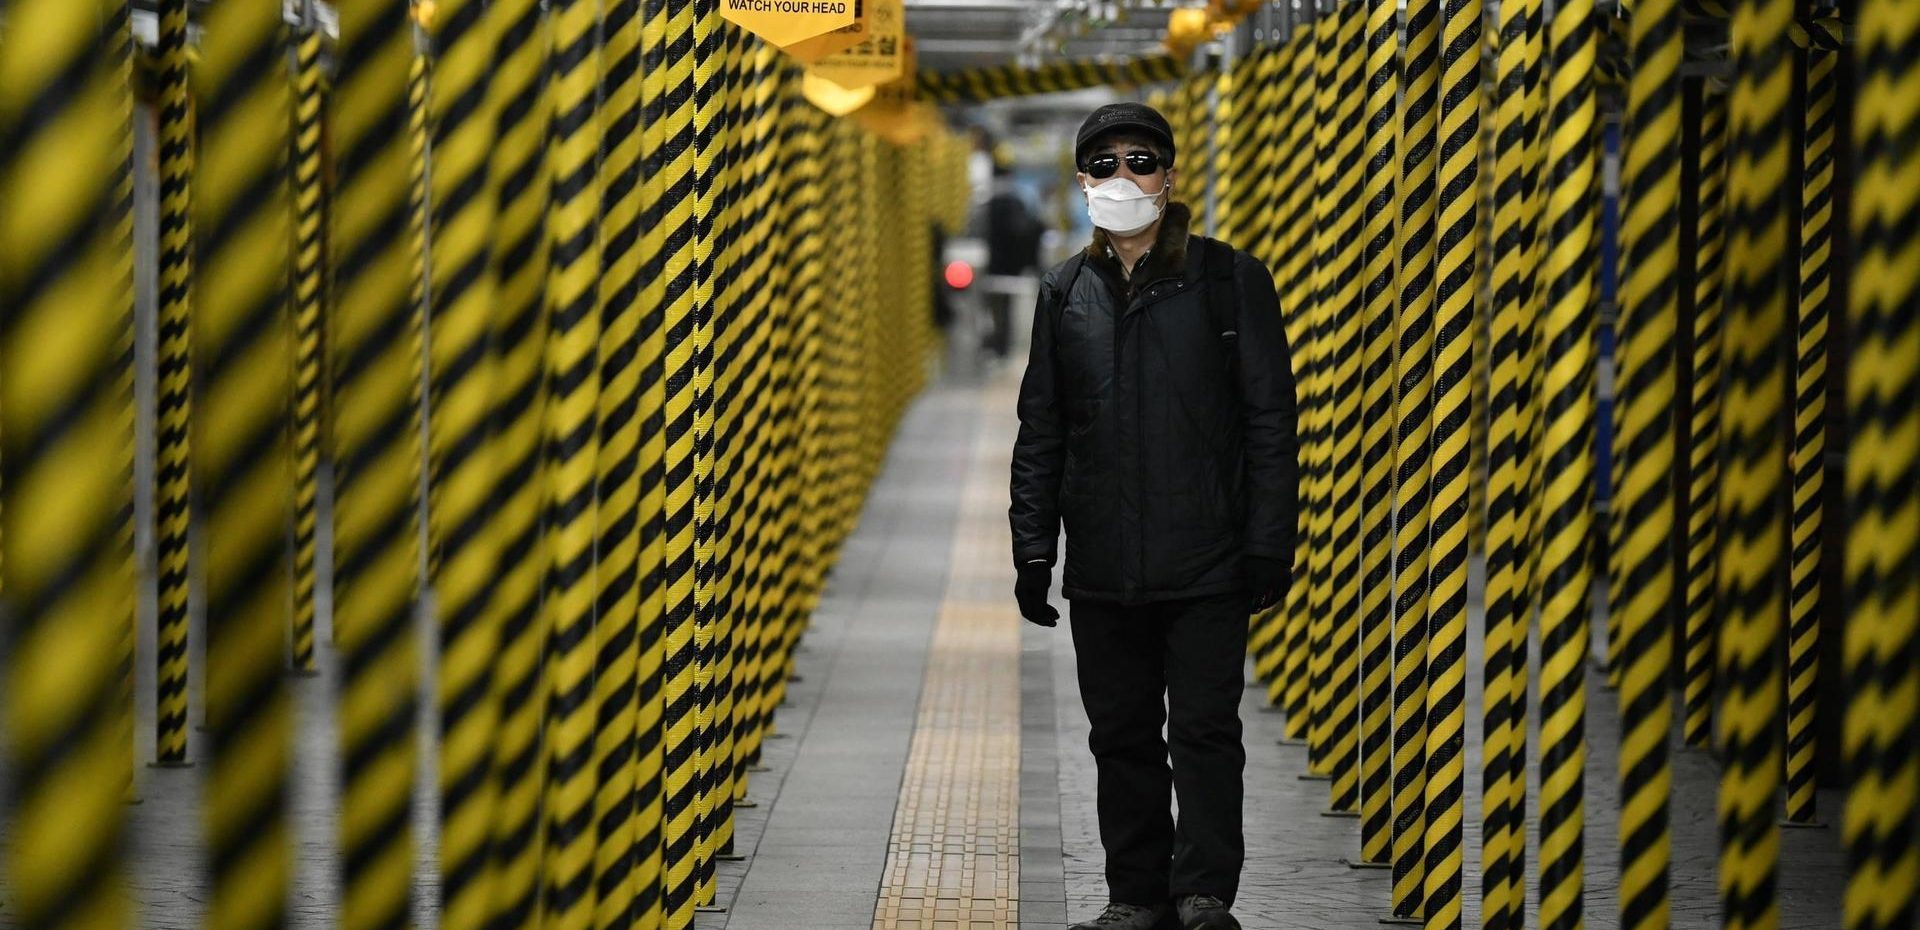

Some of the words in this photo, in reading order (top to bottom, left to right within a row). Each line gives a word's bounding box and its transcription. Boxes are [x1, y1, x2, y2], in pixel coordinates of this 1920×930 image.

[729, 0, 771, 11] WATCH
[775, 1, 809, 12] YOUR
[812, 2, 846, 13] HEAD
